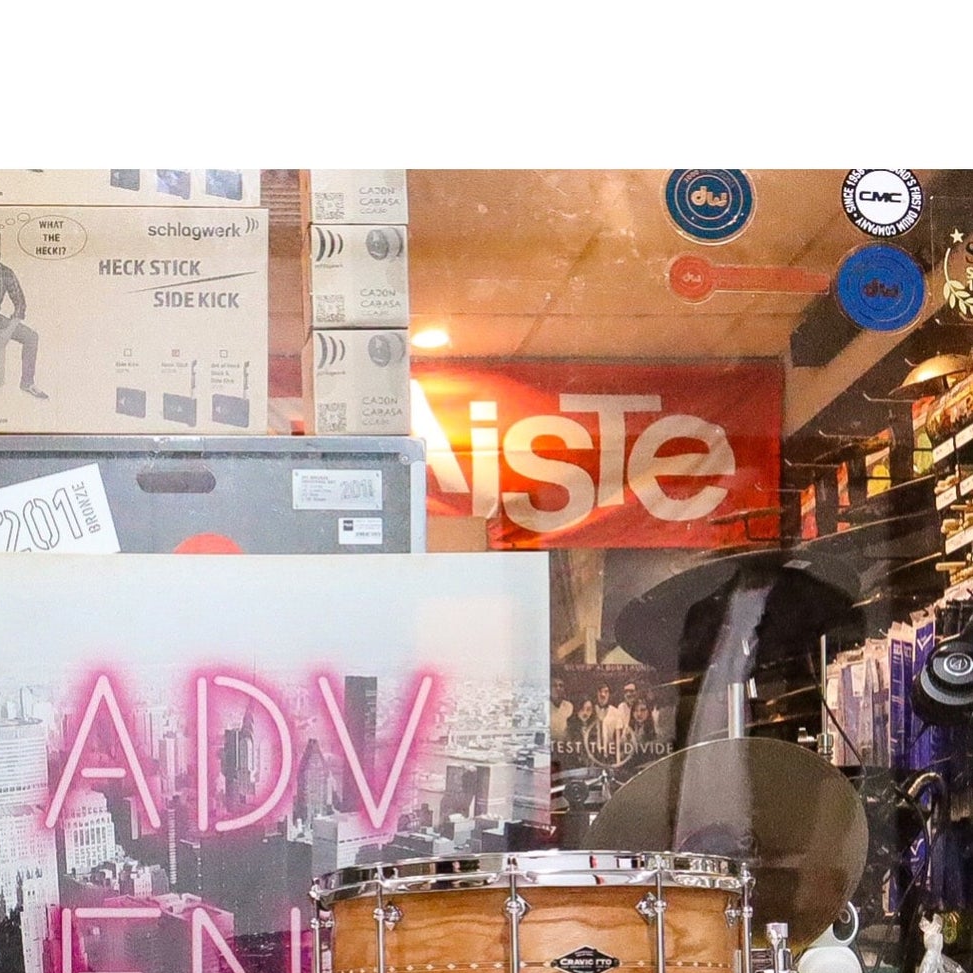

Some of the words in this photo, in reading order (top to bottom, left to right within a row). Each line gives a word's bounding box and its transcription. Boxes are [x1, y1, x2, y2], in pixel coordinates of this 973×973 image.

[691, 186, 727, 206] dw
[843, 187, 857, 213] SINCE
[859, 191, 902, 203] CMC
[909, 186, 922, 211] FIRST
[39, 220, 64, 229] WHAT
[855, 217, 897, 236] COMPANY
[896, 210, 918, 232] DRUM
[43, 233, 60, 242] THE
[148, 222, 241, 241] schlagwerk
[99, 259, 145, 275] HECK
[149, 260, 201, 276] STICK
[153, 291, 194, 308] SIDE
[199, 292, 240, 309] KICK
[72, 481, 101, 534] BRONZE
[45, 674, 433, 832] ADV
[589, 741, 616, 755] THE
[624, 742, 673, 755] DIVIDE
